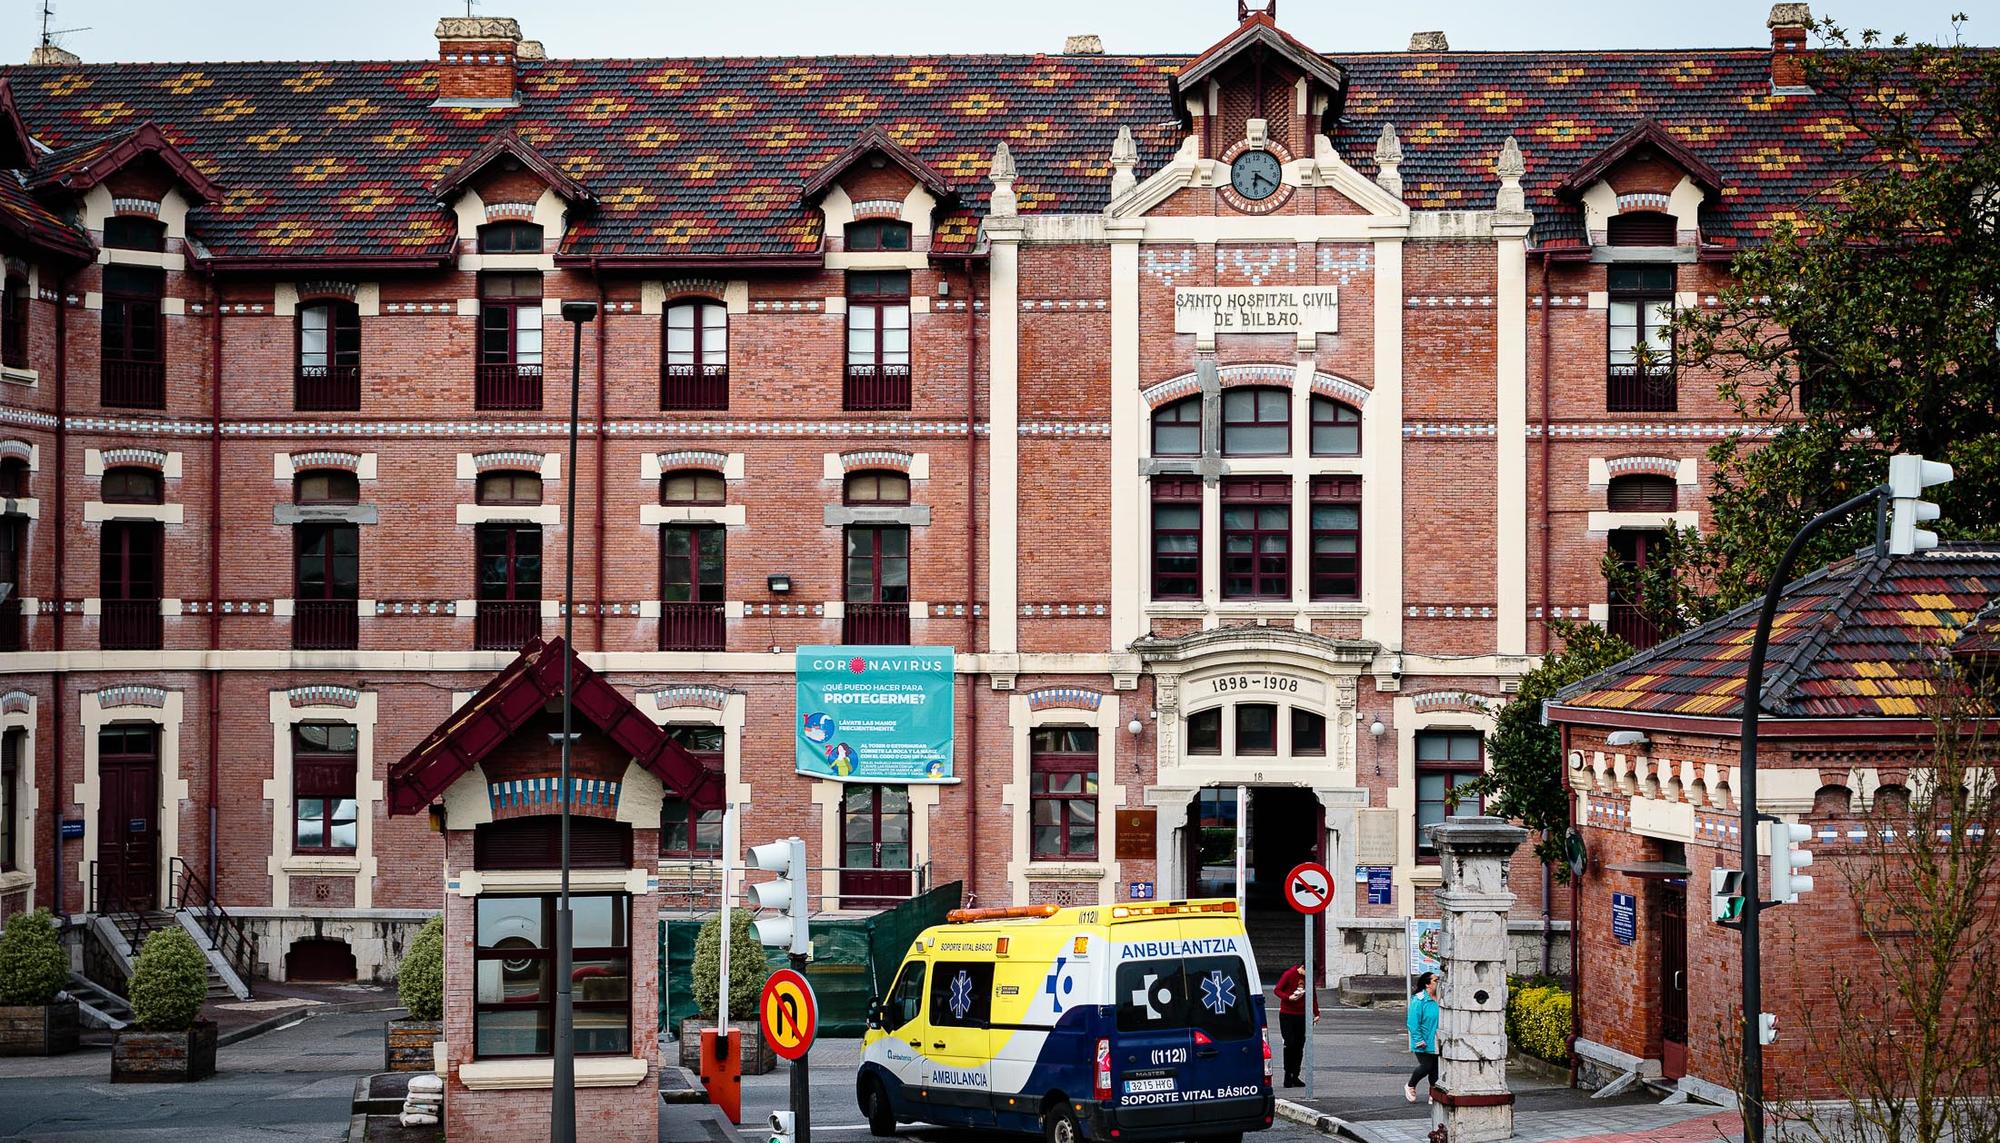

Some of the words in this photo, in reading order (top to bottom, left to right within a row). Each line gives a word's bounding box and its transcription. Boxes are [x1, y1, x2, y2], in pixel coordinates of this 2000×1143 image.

[1176, 293, 1221, 308] SANTO
[1228, 293, 1298, 308] HOSPITAL
[1303, 292, 1337, 307] CIVIL
[1214, 312, 1233, 327] DE
[1242, 312, 1302, 327] BILBAO.
[822, 683, 843, 692] ¿QUÉ
[824, 693, 926, 704] PROTEGERME?
[1254, 772, 1263, 781] 18
[940, 943, 961, 951] SOPORTE
[962, 943, 974, 951] VITAL
[1121, 938, 1238, 959] ANBULANTZIA
[932, 1070, 988, 1087] AMBULANCIA
[1136, 1070, 1165, 1078] MASTER
[1131, 1080, 1154, 1091] 3215
[1121, 1091, 1179, 1106] SOPORTE
[1181, 1089, 1215, 1101] VITAL
[1217, 1085, 1258, 1098] BÁSICO
